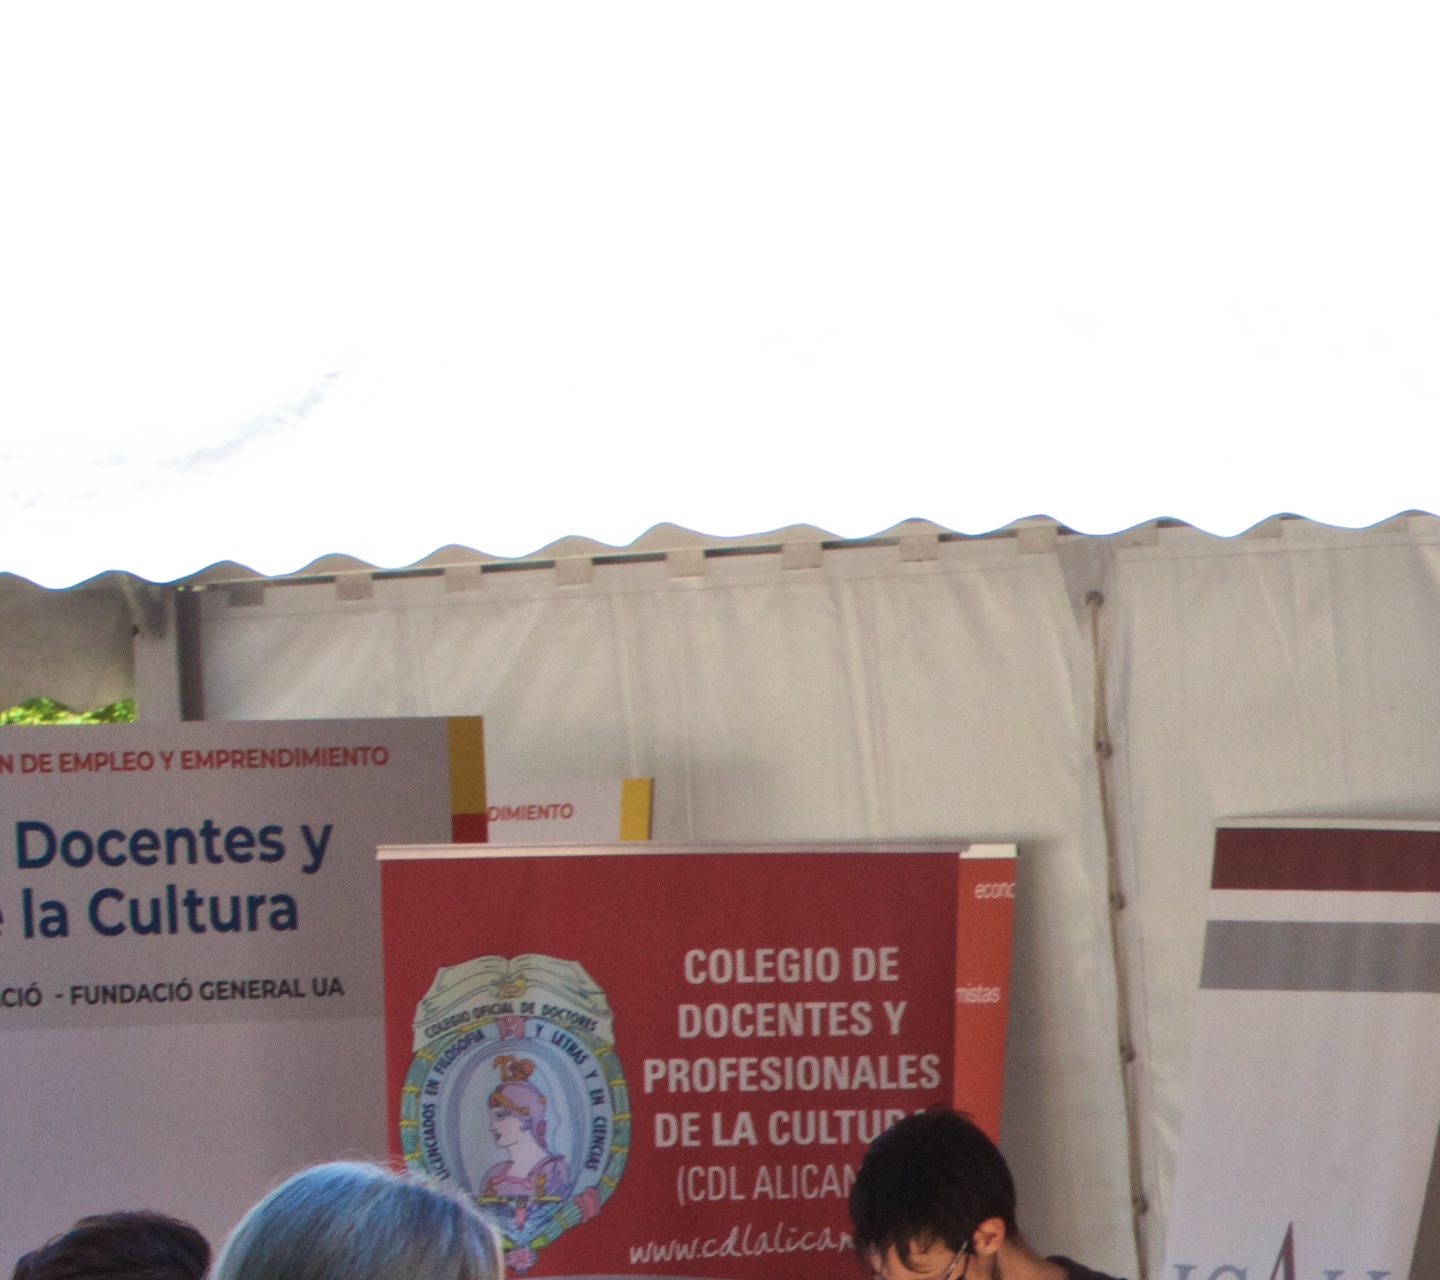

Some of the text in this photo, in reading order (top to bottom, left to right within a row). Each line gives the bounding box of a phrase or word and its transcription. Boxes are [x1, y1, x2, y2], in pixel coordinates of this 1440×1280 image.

[21, 752, 53, 774] DE
[59, 750, 155, 773] EMPLEO
[159, 751, 176, 770] Y
[181, 746, 390, 770] EMPRENDIMIENTO
[486, 801, 574, 822] DIMIENTO
[14, 819, 334, 874] Docentes y
[22, 883, 299, 939] la Cultura
[684, 947, 899, 984] COLEGIO DE
[70, 977, 192, 1006] FUNDACIÓ
[200, 978, 306, 1001] GENERAL
[313, 976, 344, 996] UA
[424, 1001, 598, 1038] COLEGIO OFICIAL DE DOCTORES
[535, 1023, 544, 1036] Y
[678, 1001, 907, 1038] DOCENTES Y
[551, 1030, 589, 1066] LETRAS
[425, 1078, 440, 1096] EN
[585, 1069, 599, 1080] Y
[644, 1054, 941, 1093] PROFESIONALES
[590, 1088, 606, 1106] EN
[422, 1103, 450, 1181] LICENCIADOS
[584, 1116, 608, 1173] CIENCIAS
[654, 1112, 700, 1147] DE
[712, 1111, 758, 1147] LA
[676, 1165, 745, 1206] (CDL
